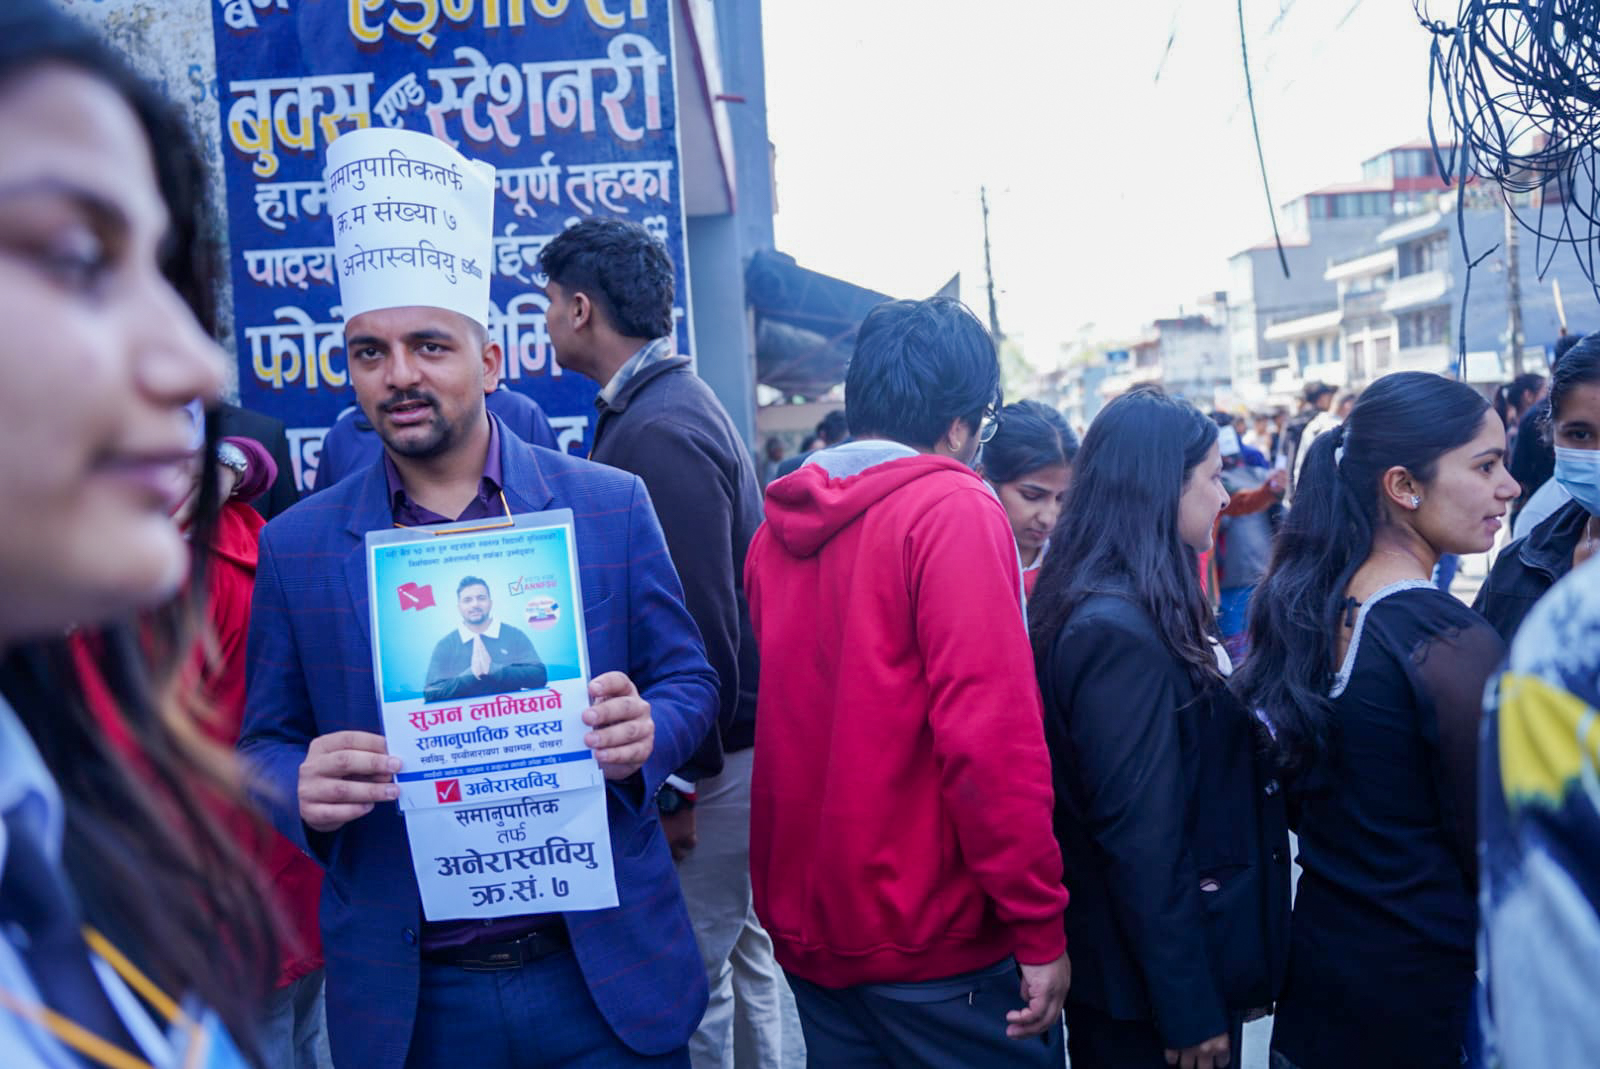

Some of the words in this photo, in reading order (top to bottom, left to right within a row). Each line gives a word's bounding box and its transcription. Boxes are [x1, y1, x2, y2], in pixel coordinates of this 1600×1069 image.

[425, 33, 667, 149] स्टेशनरी
[565, 161, 673, 215] तहका
[372, 196, 437, 225] संख्या
[443, 210, 457, 231] ७
[343, 239, 457, 284] अनेरास्ववियु
[408, 705, 462, 732] सुजन
[469, 689, 563, 721] लामिछाने
[515, 720, 563, 738] सदस्य
[465, 771, 560, 796] अनेरास्ववियु
[454, 796, 560, 826] समानुपातिक
[497, 822, 526, 844] तर्फ
[434, 836, 599, 876] अनेरास्ववियु
[552, 877, 569, 898] ७
